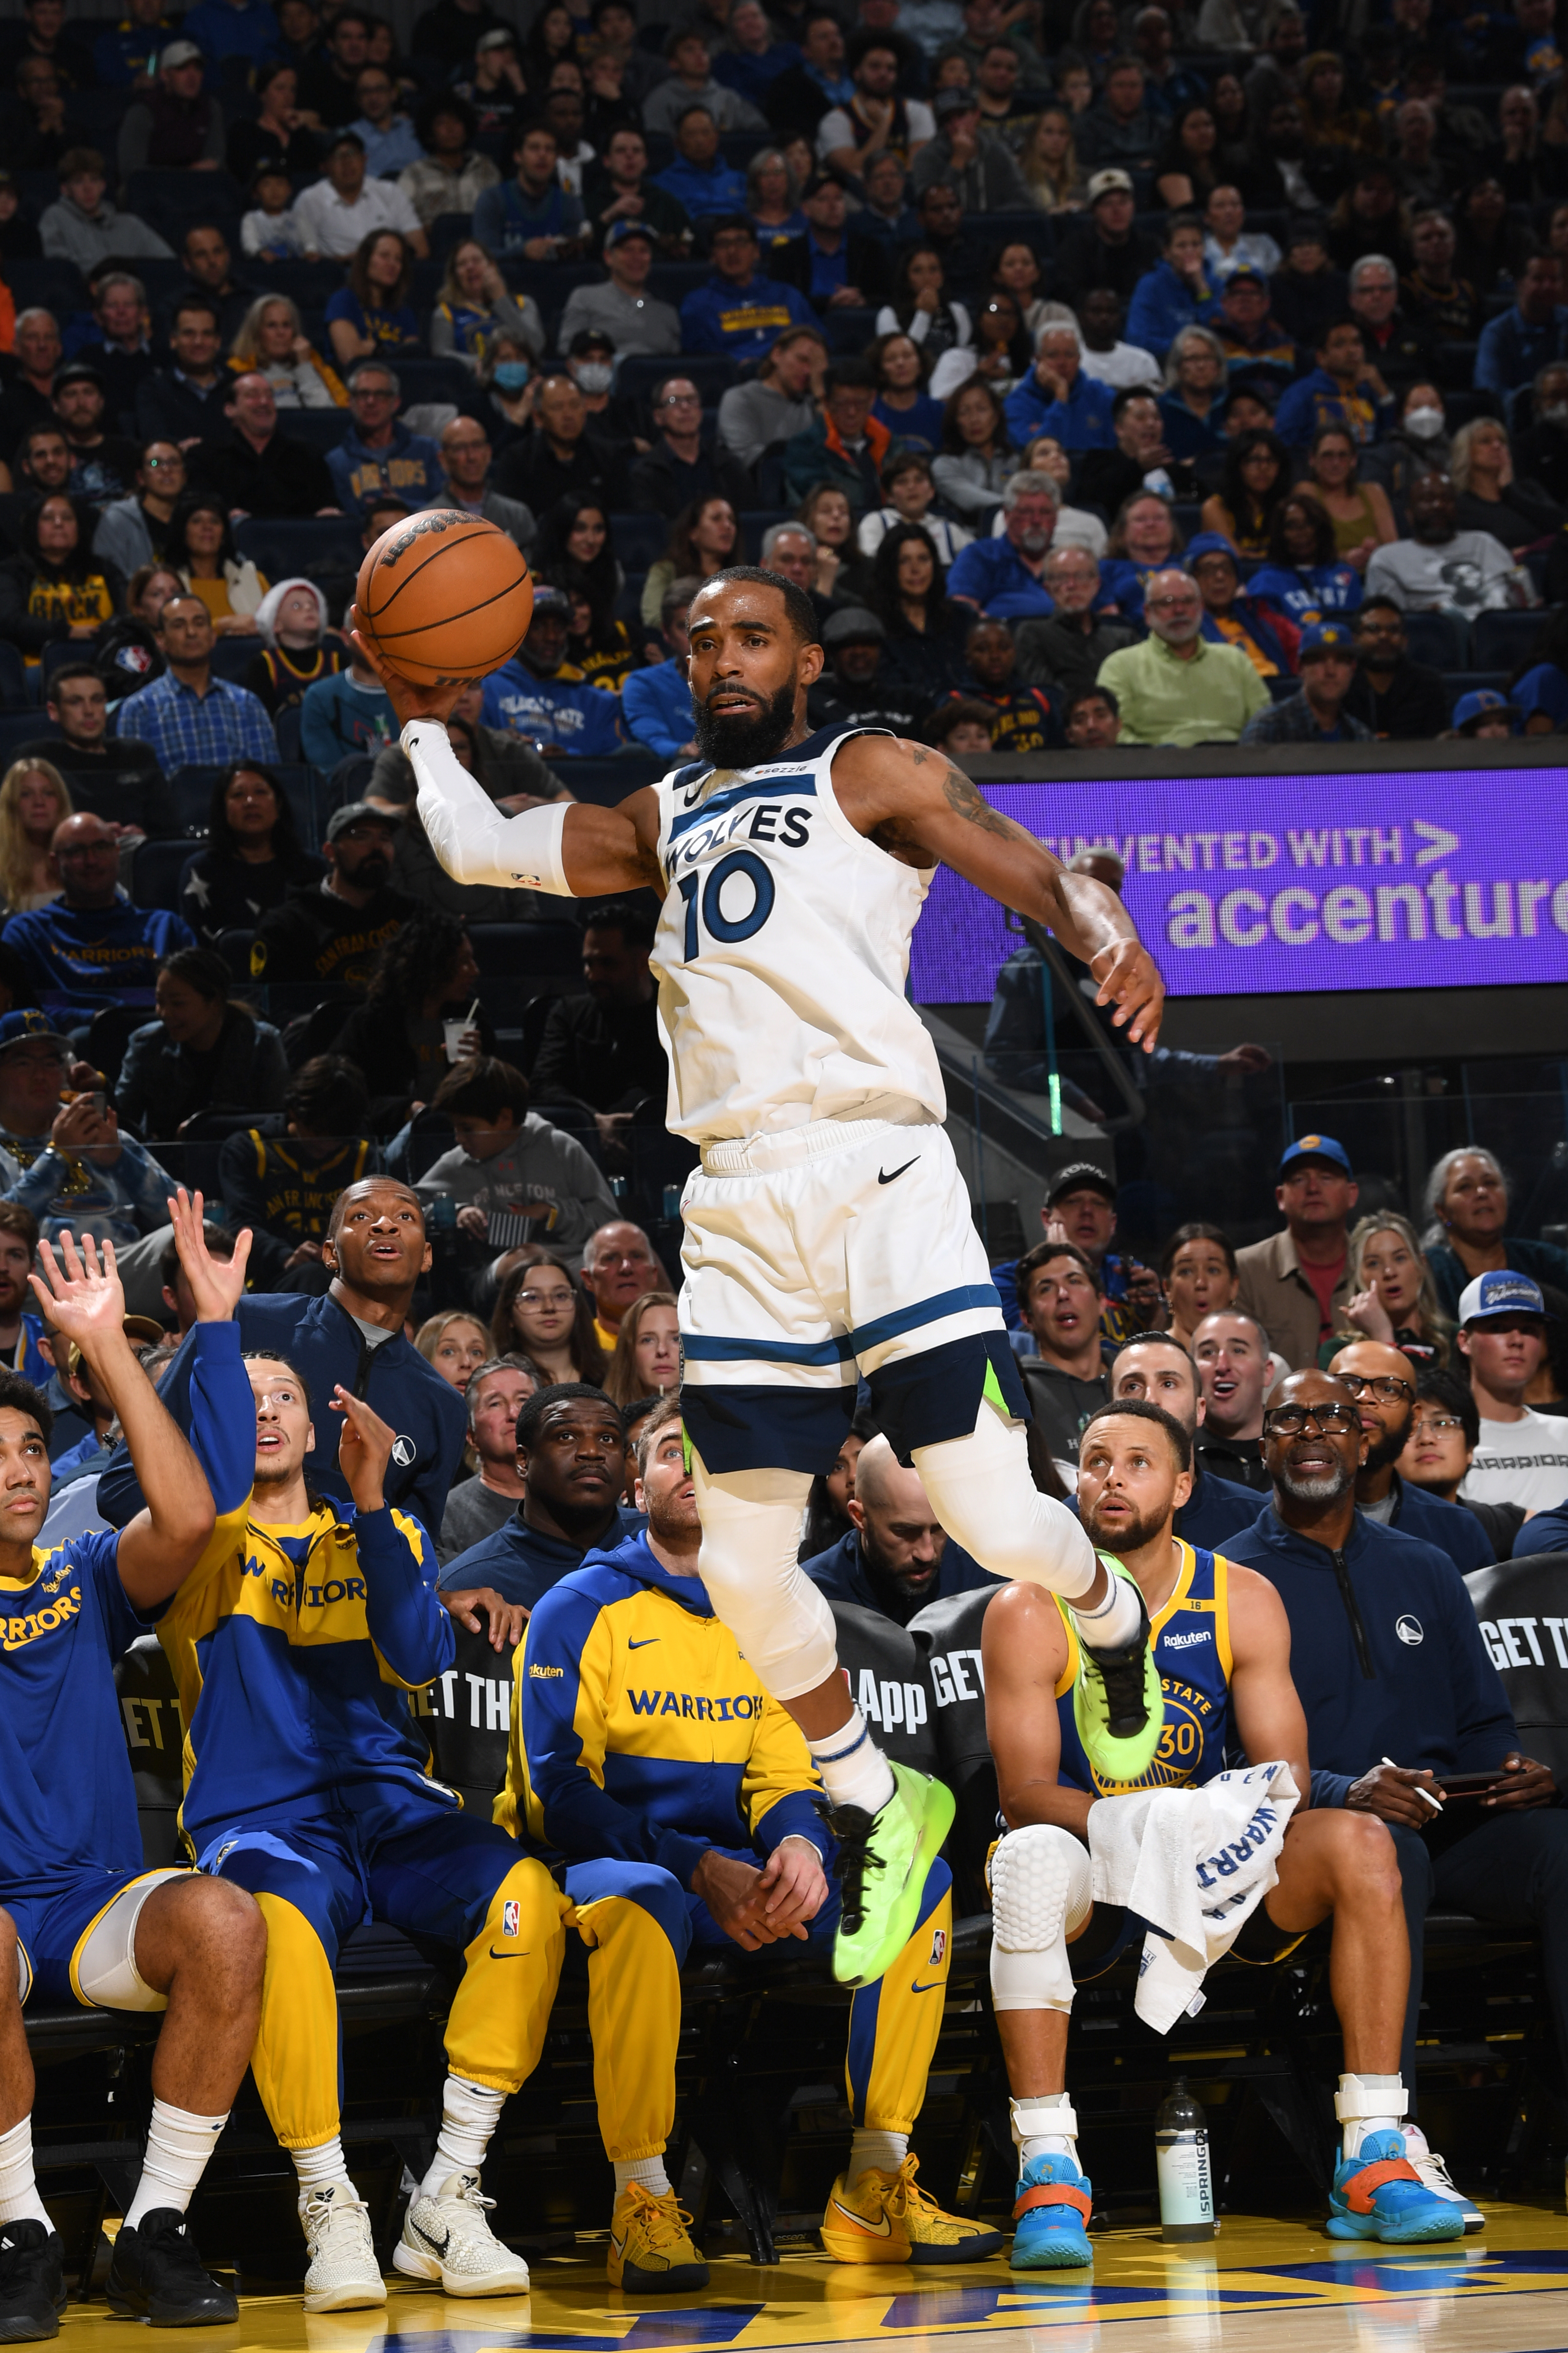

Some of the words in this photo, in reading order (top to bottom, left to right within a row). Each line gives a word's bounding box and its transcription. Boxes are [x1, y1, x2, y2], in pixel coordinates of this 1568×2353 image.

[666, 805, 813, 881] WOLVES
[1287, 827, 1403, 866] WITH
[677, 850, 776, 964] 10
[1060, 1163, 1106, 1179] TOWN
[41, 1564, 74, 1593] Rakuten
[1190, 1601, 1201, 1609] 16
[1164, 1631, 1211, 1647] Rakuten
[1478, 1616, 1545, 1671] GET
[529, 1664, 564, 1678] akuten
[859, 1669, 928, 1734] App
[1161, 1678, 1212, 1715] STATE
[1156, 1723, 1195, 1759] 30
[1197, 2147, 1210, 2212] SPRING
